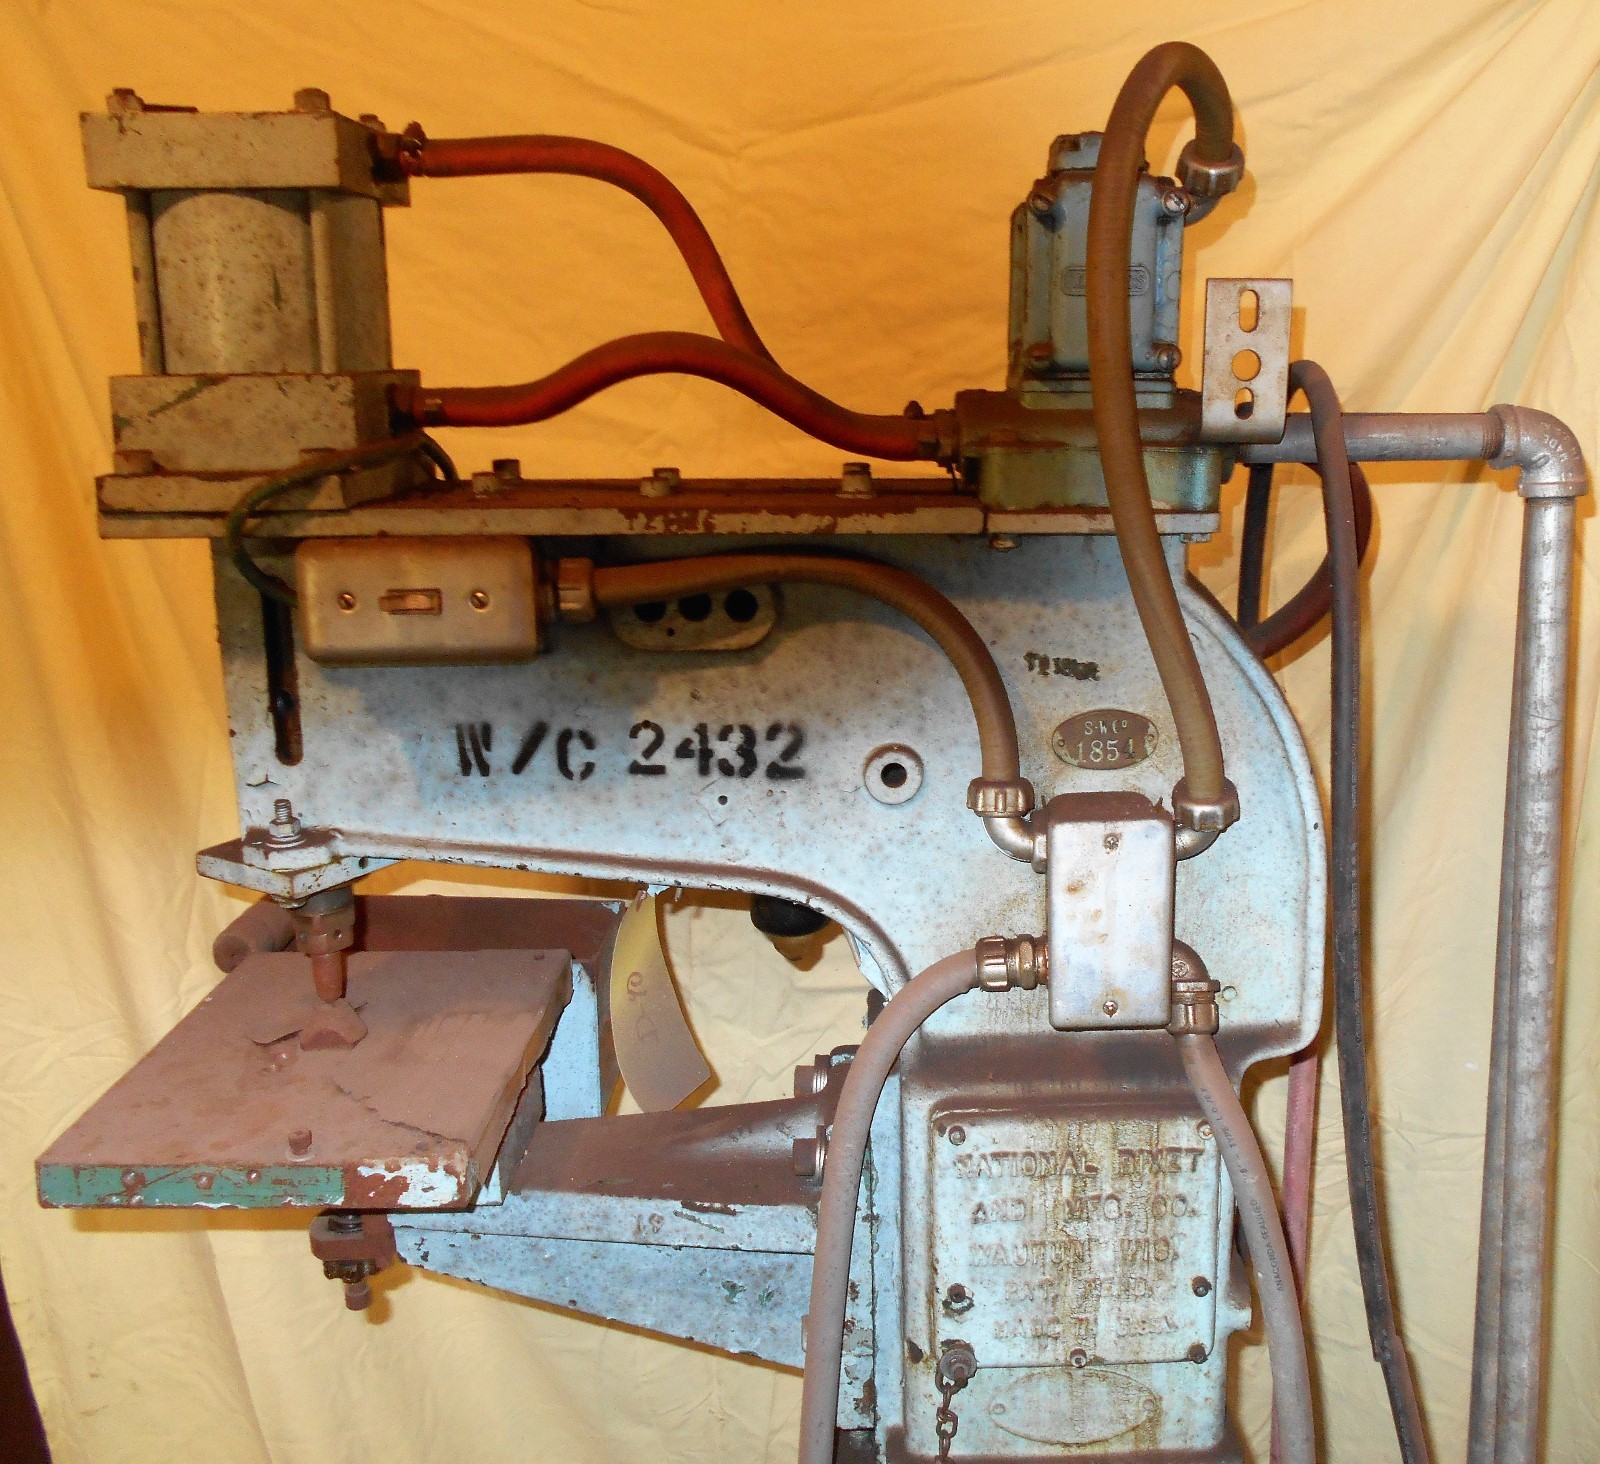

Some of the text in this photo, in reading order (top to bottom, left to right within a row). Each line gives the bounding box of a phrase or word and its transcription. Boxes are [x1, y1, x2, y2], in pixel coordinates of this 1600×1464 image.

[455, 720, 805, 780] W/C 2432
[953, 1149, 1100, 1178] NATIONAL
[971, 1197, 1028, 1224] AND
